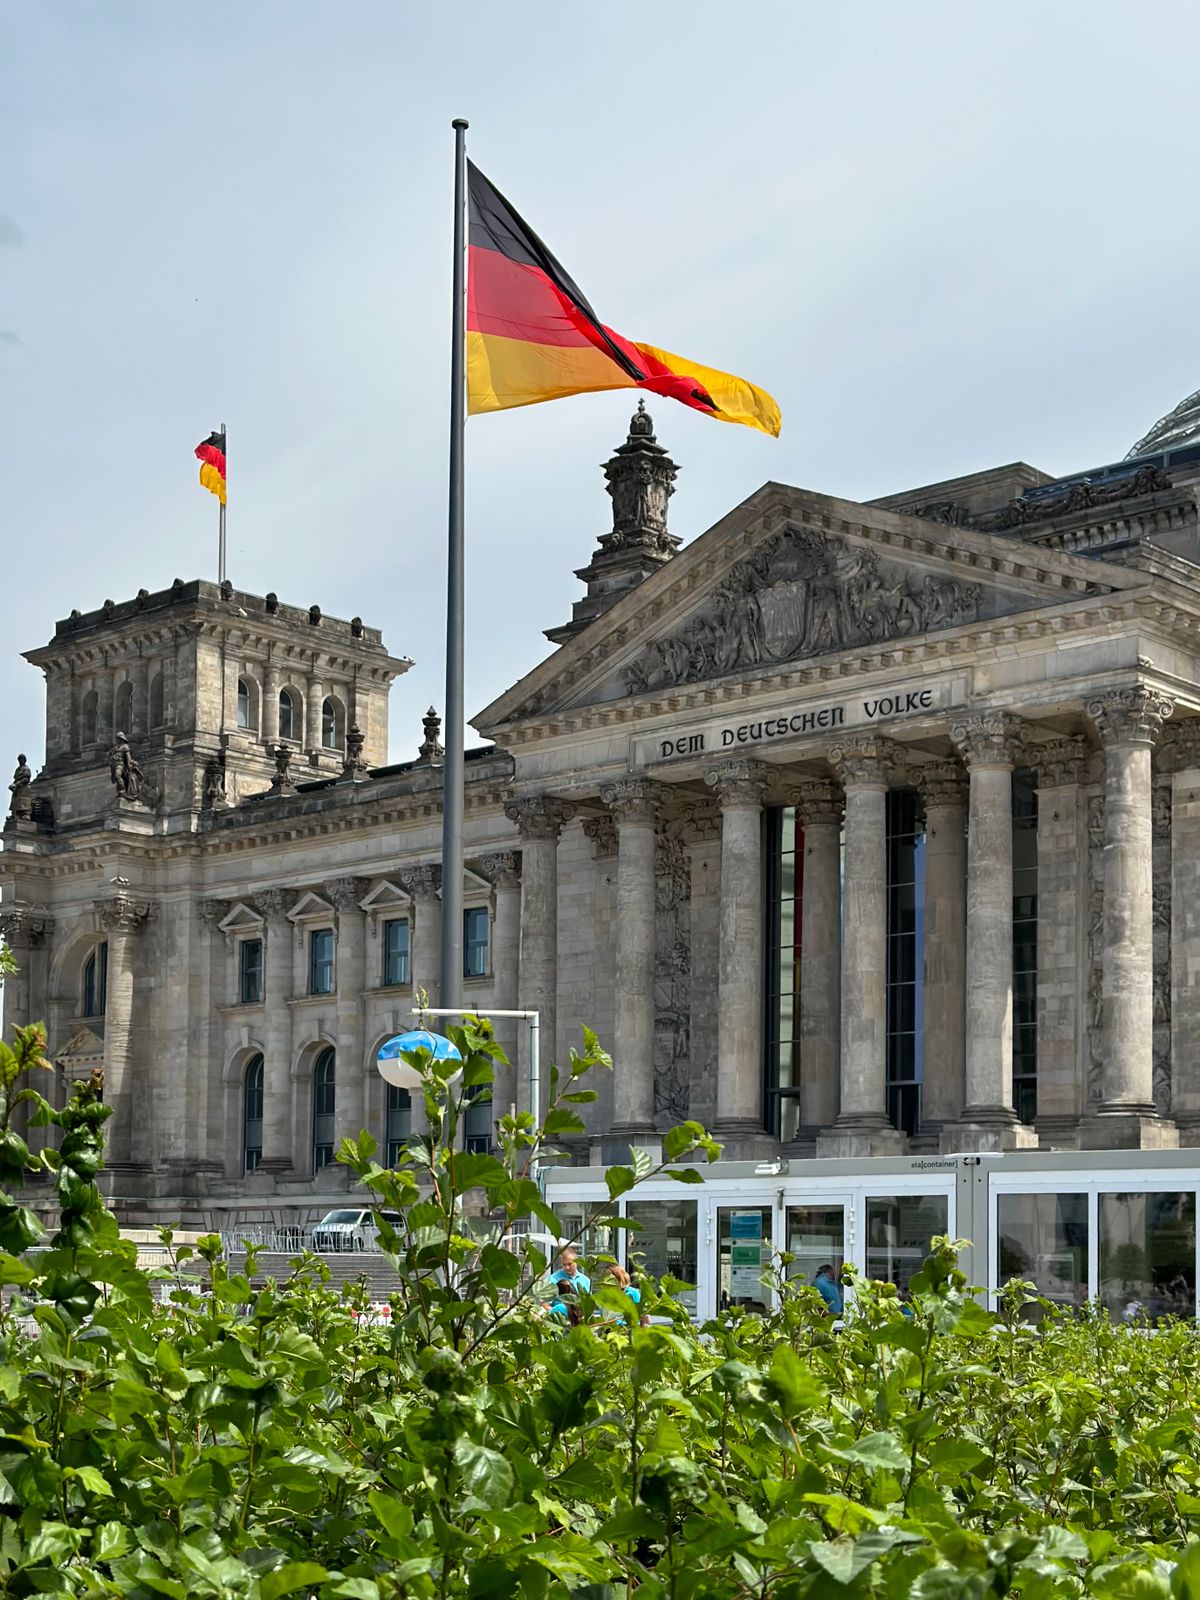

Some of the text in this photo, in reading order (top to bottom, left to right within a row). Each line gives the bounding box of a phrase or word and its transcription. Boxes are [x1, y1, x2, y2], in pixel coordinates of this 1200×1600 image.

[661, 690, 932, 757] DEM DEUTSCHEN VOLKE
